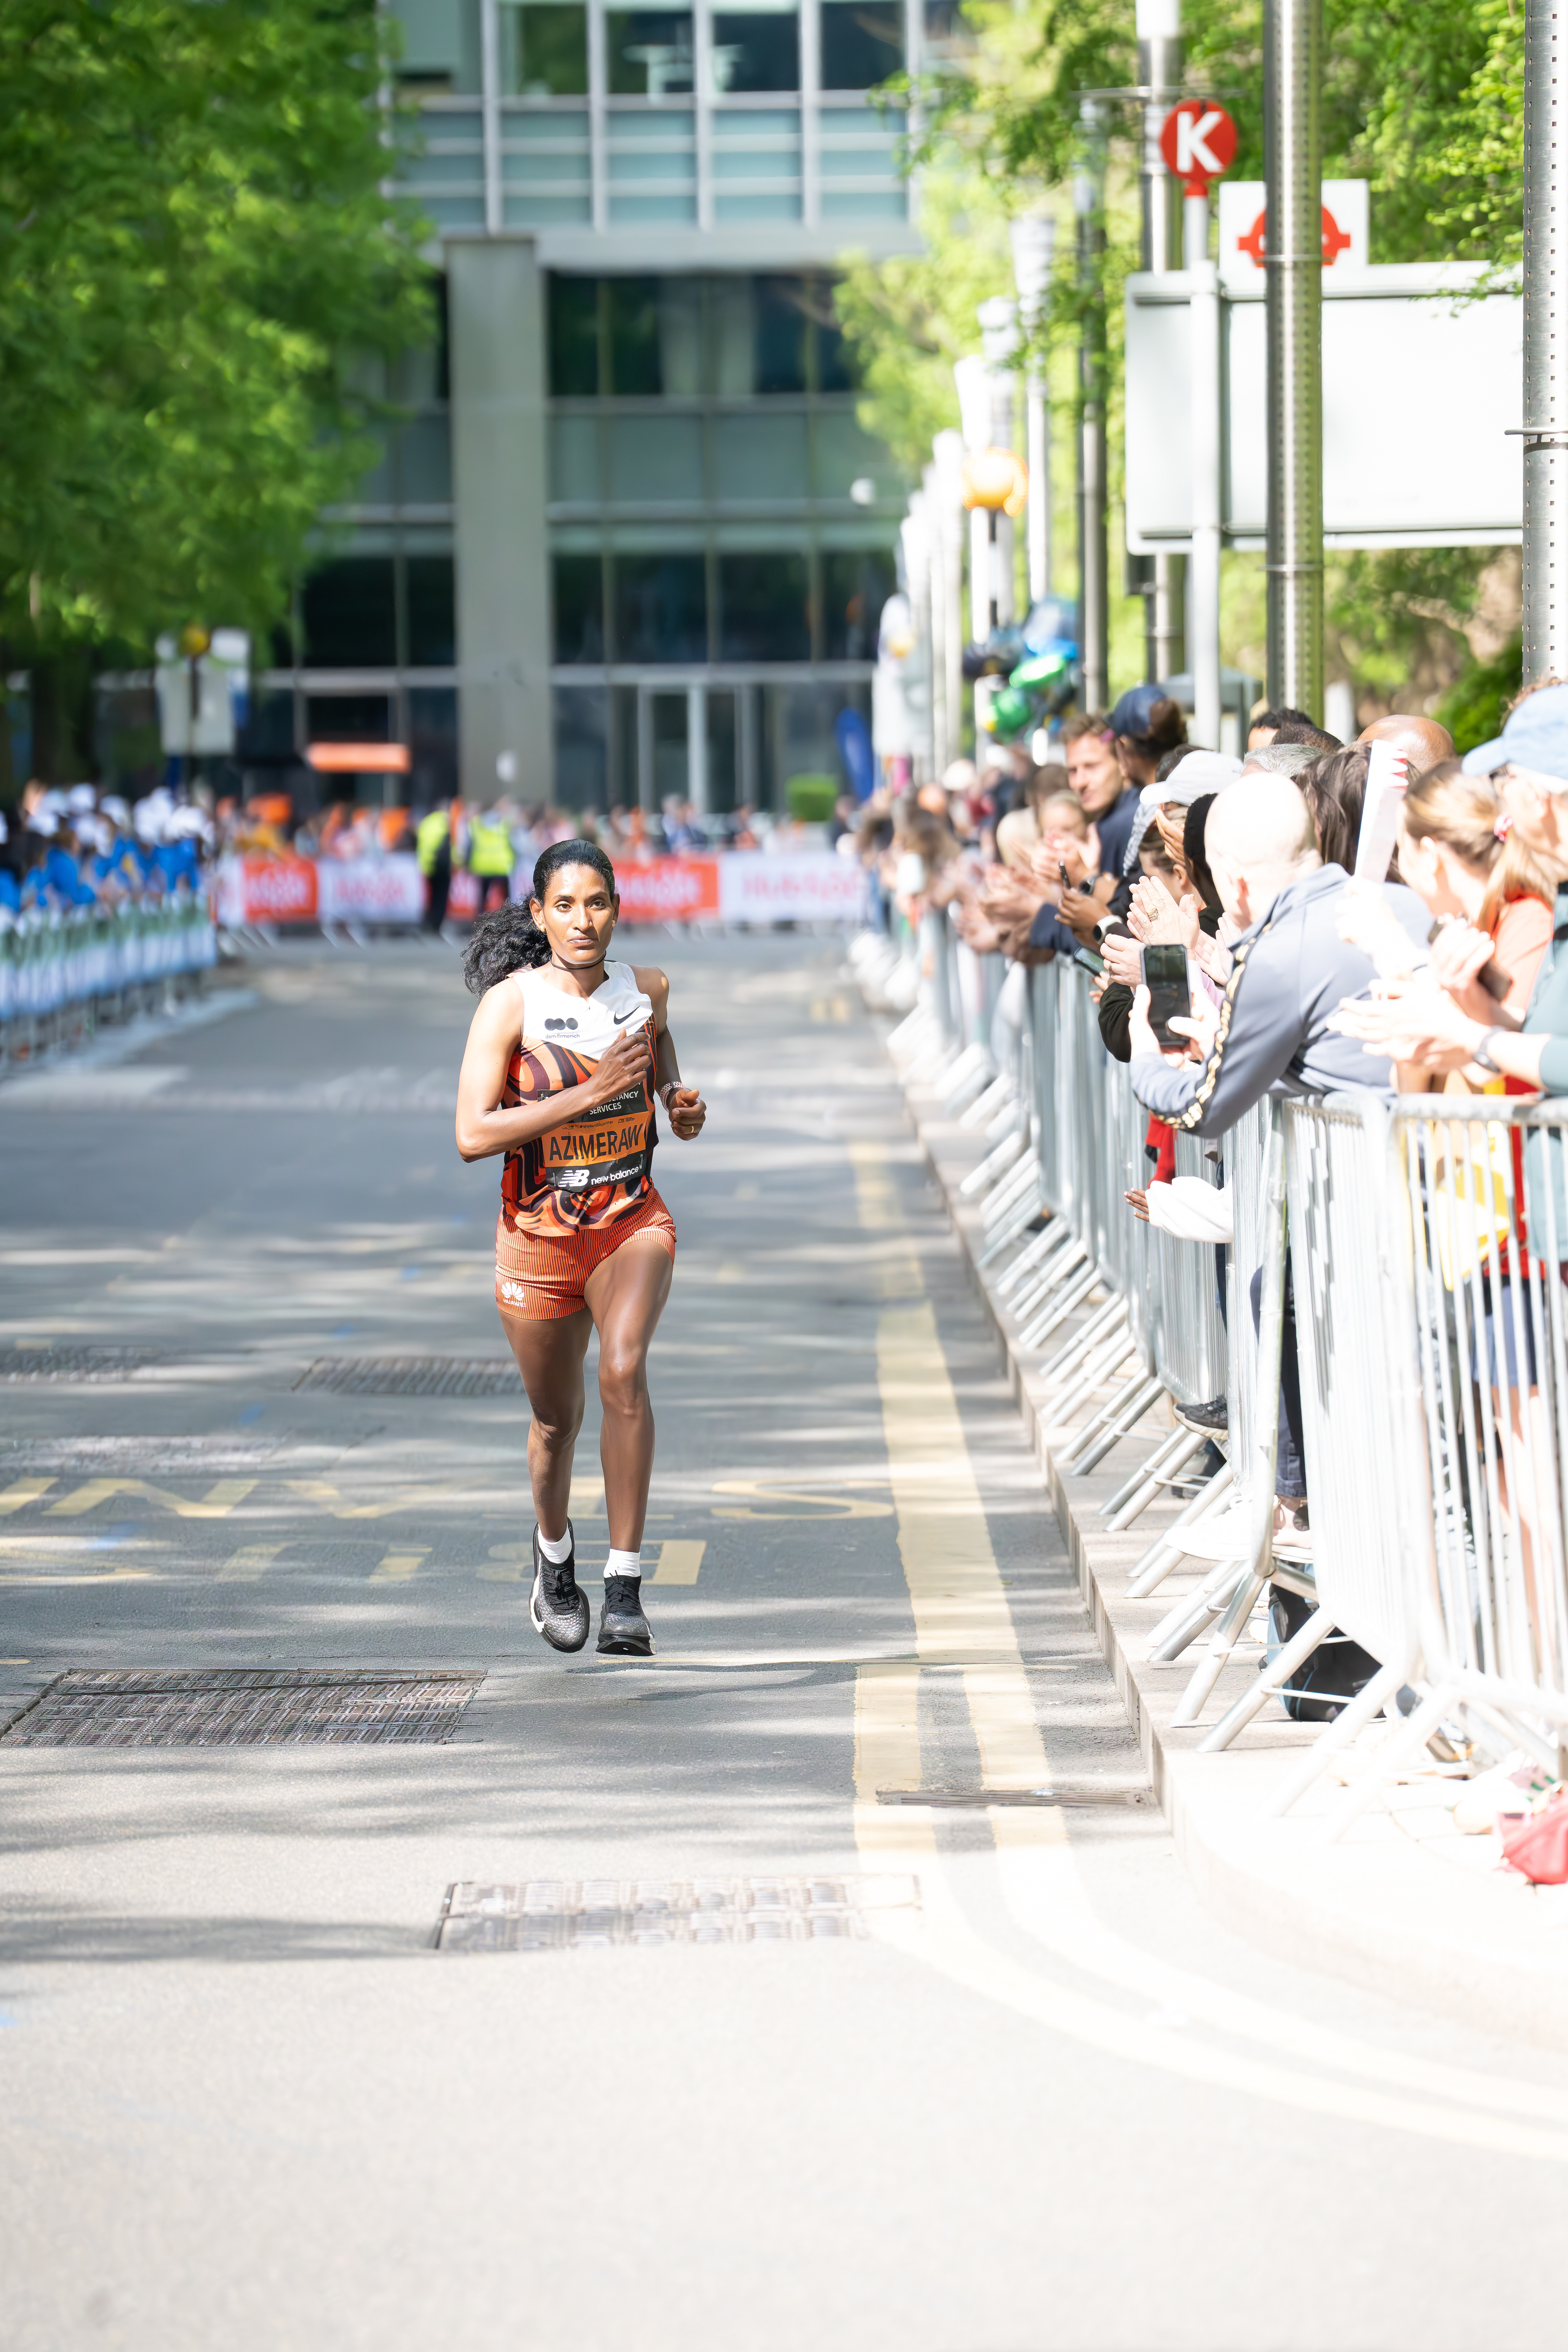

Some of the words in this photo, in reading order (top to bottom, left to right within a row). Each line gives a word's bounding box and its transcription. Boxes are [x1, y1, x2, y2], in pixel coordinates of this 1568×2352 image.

[1176, 110, 1225, 174] K
[590, 1102, 621, 1115] SERVICES
[549, 1123, 644, 1161] AZIMERAW
[610, 1166, 639, 1181] balance
[503, 1298, 526, 1307] HUAWEI
[0, 1476, 895, 1520] STAN
